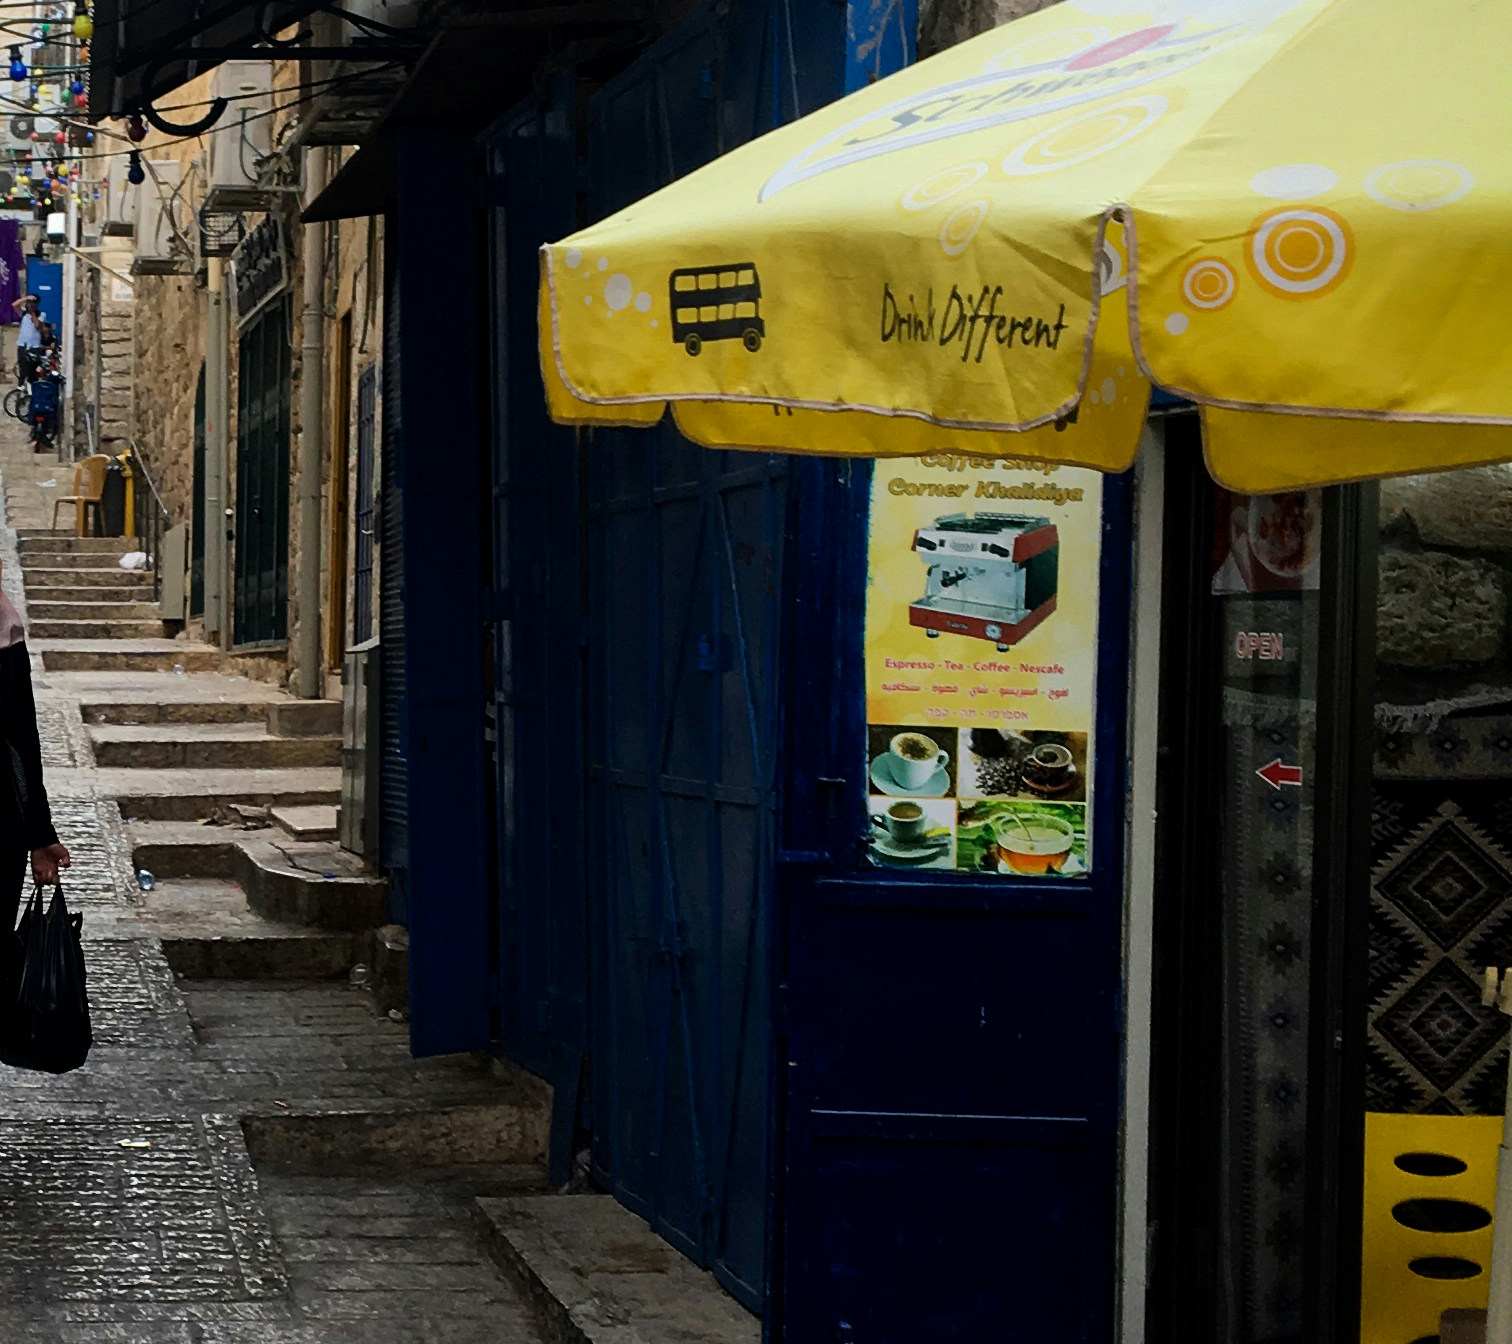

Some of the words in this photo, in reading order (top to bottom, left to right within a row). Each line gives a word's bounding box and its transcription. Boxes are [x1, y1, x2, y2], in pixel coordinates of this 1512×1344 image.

[881, 283, 936, 343] Drink
[939, 284, 1068, 363] Different
[887, 477, 969, 498] Corner
[1235, 631, 1284, 661] OPEN
[885, 658, 935, 672] Espresso
[945, 660, 964, 671] Tea
[973, 661, 1010, 673] Coffee
[1020, 662, 1065, 675] Nescafe
